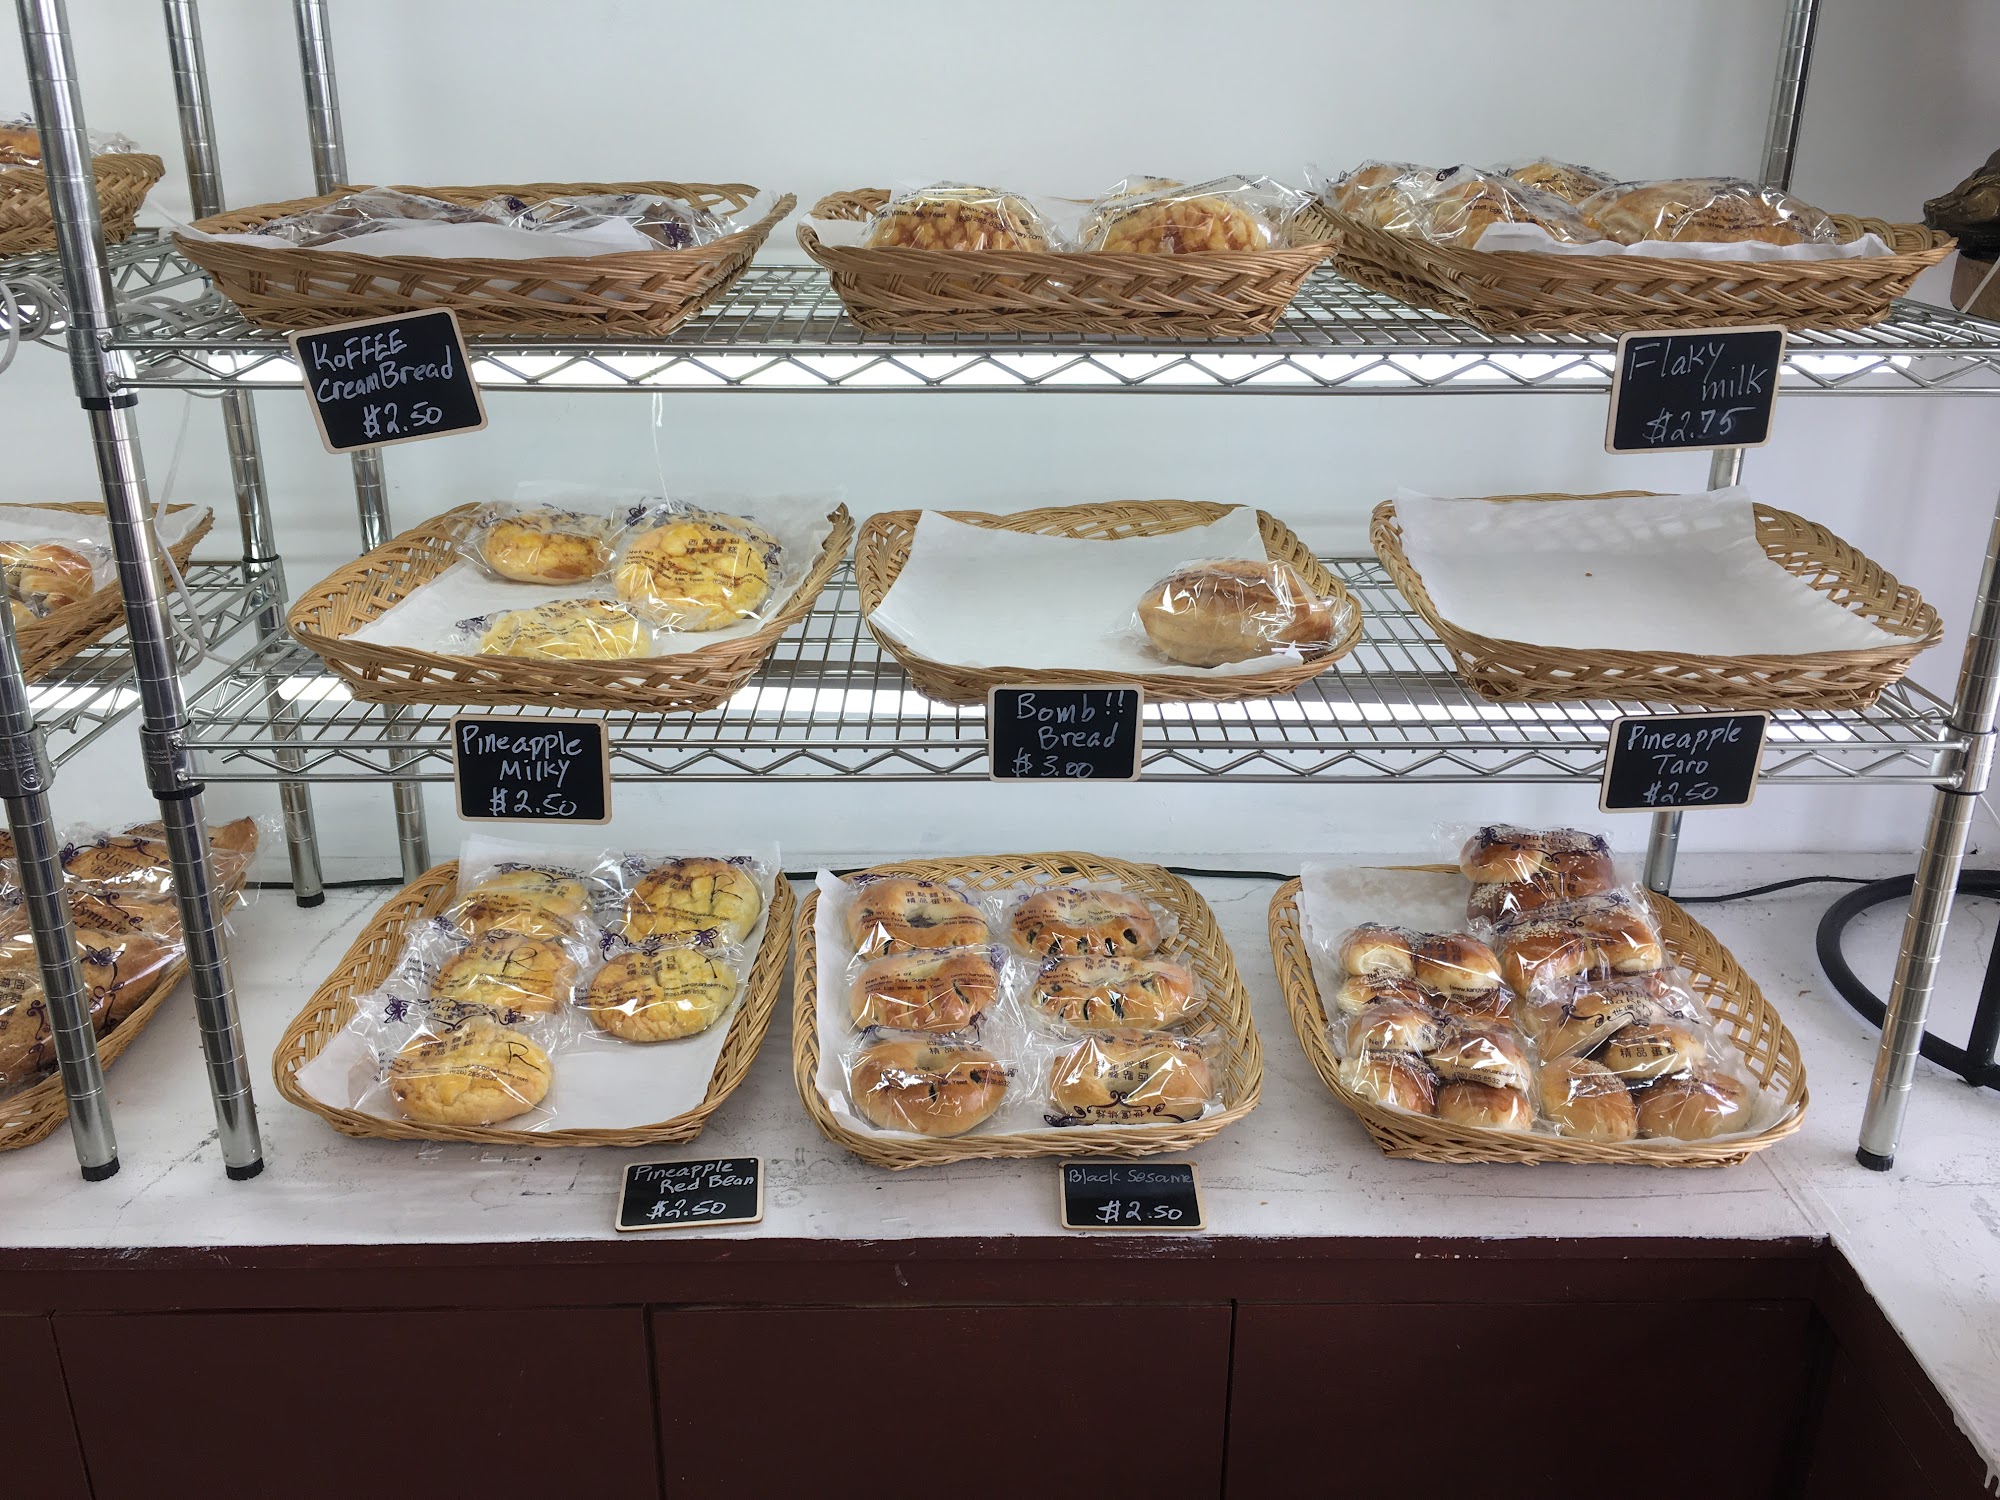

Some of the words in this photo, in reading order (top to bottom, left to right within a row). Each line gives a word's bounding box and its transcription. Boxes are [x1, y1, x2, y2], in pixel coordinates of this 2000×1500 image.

[1629, 338, 1726, 384] Flaky
[363, 401, 443, 438] $2.50
[1643, 407, 1757, 444] $2.75
[462, 725, 583, 760] Pineapple
[1037, 722, 1119, 750] Bread
[1627, 718, 1743, 755] Pineapple
[1652, 753, 1709, 775] Taro
[489, 786, 578, 816] $2.50
[1643, 780, 1720, 805] $2.50
[506, 1041, 545, 1074] R
[633, 1160, 734, 1182] Pineapple
[659, 1177, 700, 1195] Red
[708, 1174, 754, 1188] Bean
[1068, 1168, 1121, 1185] Black
[1127, 1169, 1194, 1184] Sesame
[645, 1198, 727, 1220] $2.50
[1095, 1199, 1183, 1224] $2.50
